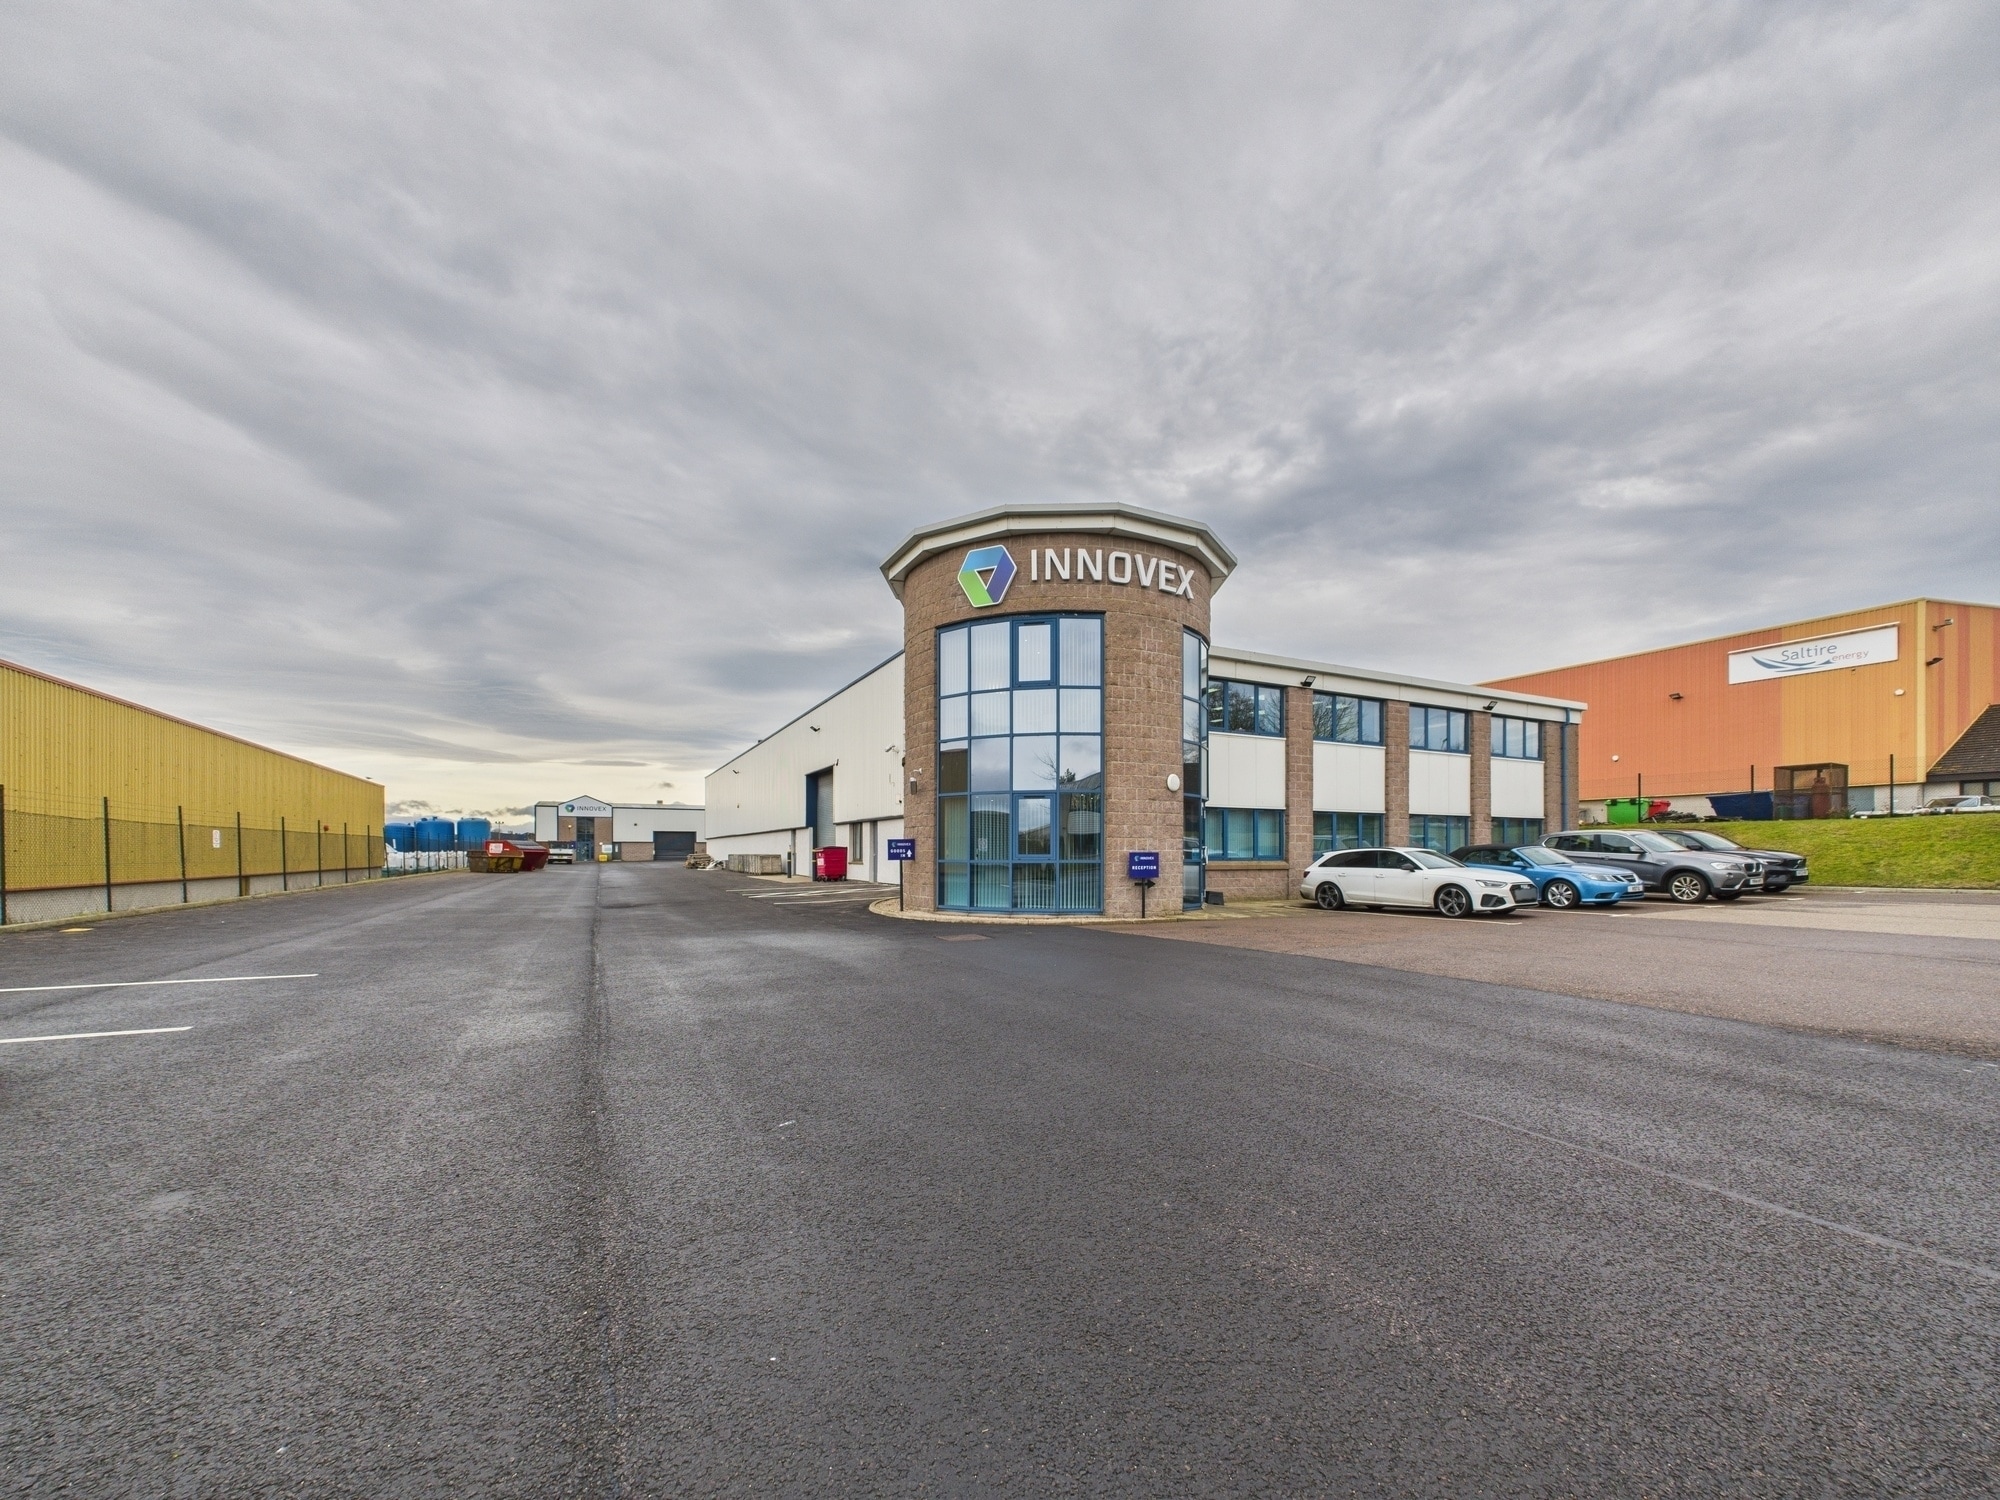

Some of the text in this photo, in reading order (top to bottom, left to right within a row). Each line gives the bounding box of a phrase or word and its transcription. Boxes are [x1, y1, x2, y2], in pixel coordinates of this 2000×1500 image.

[1030, 547, 1195, 600] INNOVEX
[1781, 643, 1838, 662] Saltire
[1831, 650, 1870, 662] energy
